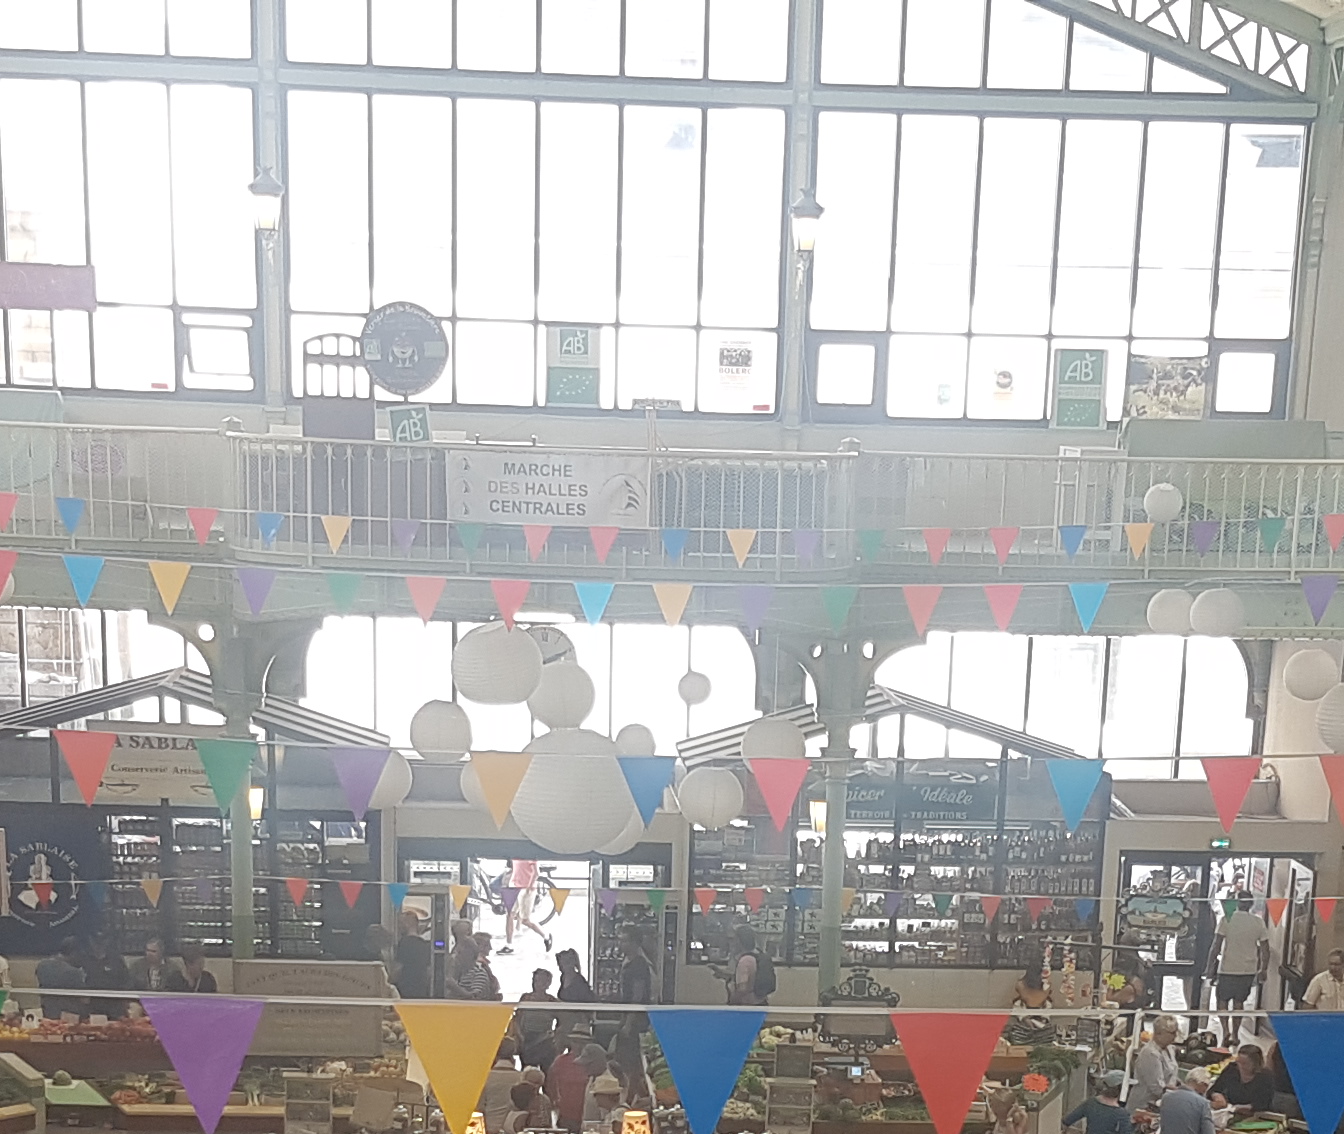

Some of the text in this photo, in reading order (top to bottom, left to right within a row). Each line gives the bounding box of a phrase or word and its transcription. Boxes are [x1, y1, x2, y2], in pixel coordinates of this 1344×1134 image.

[562, 336, 585, 355] AB
[1064, 359, 1093, 382] AB
[396, 419, 424, 442] AB
[503, 462, 573, 478] MARCHE
[487, 480, 588, 498] DES HALLES
[489, 499, 587, 516] CENTRALES
[129, 735, 197, 750] SABLA
